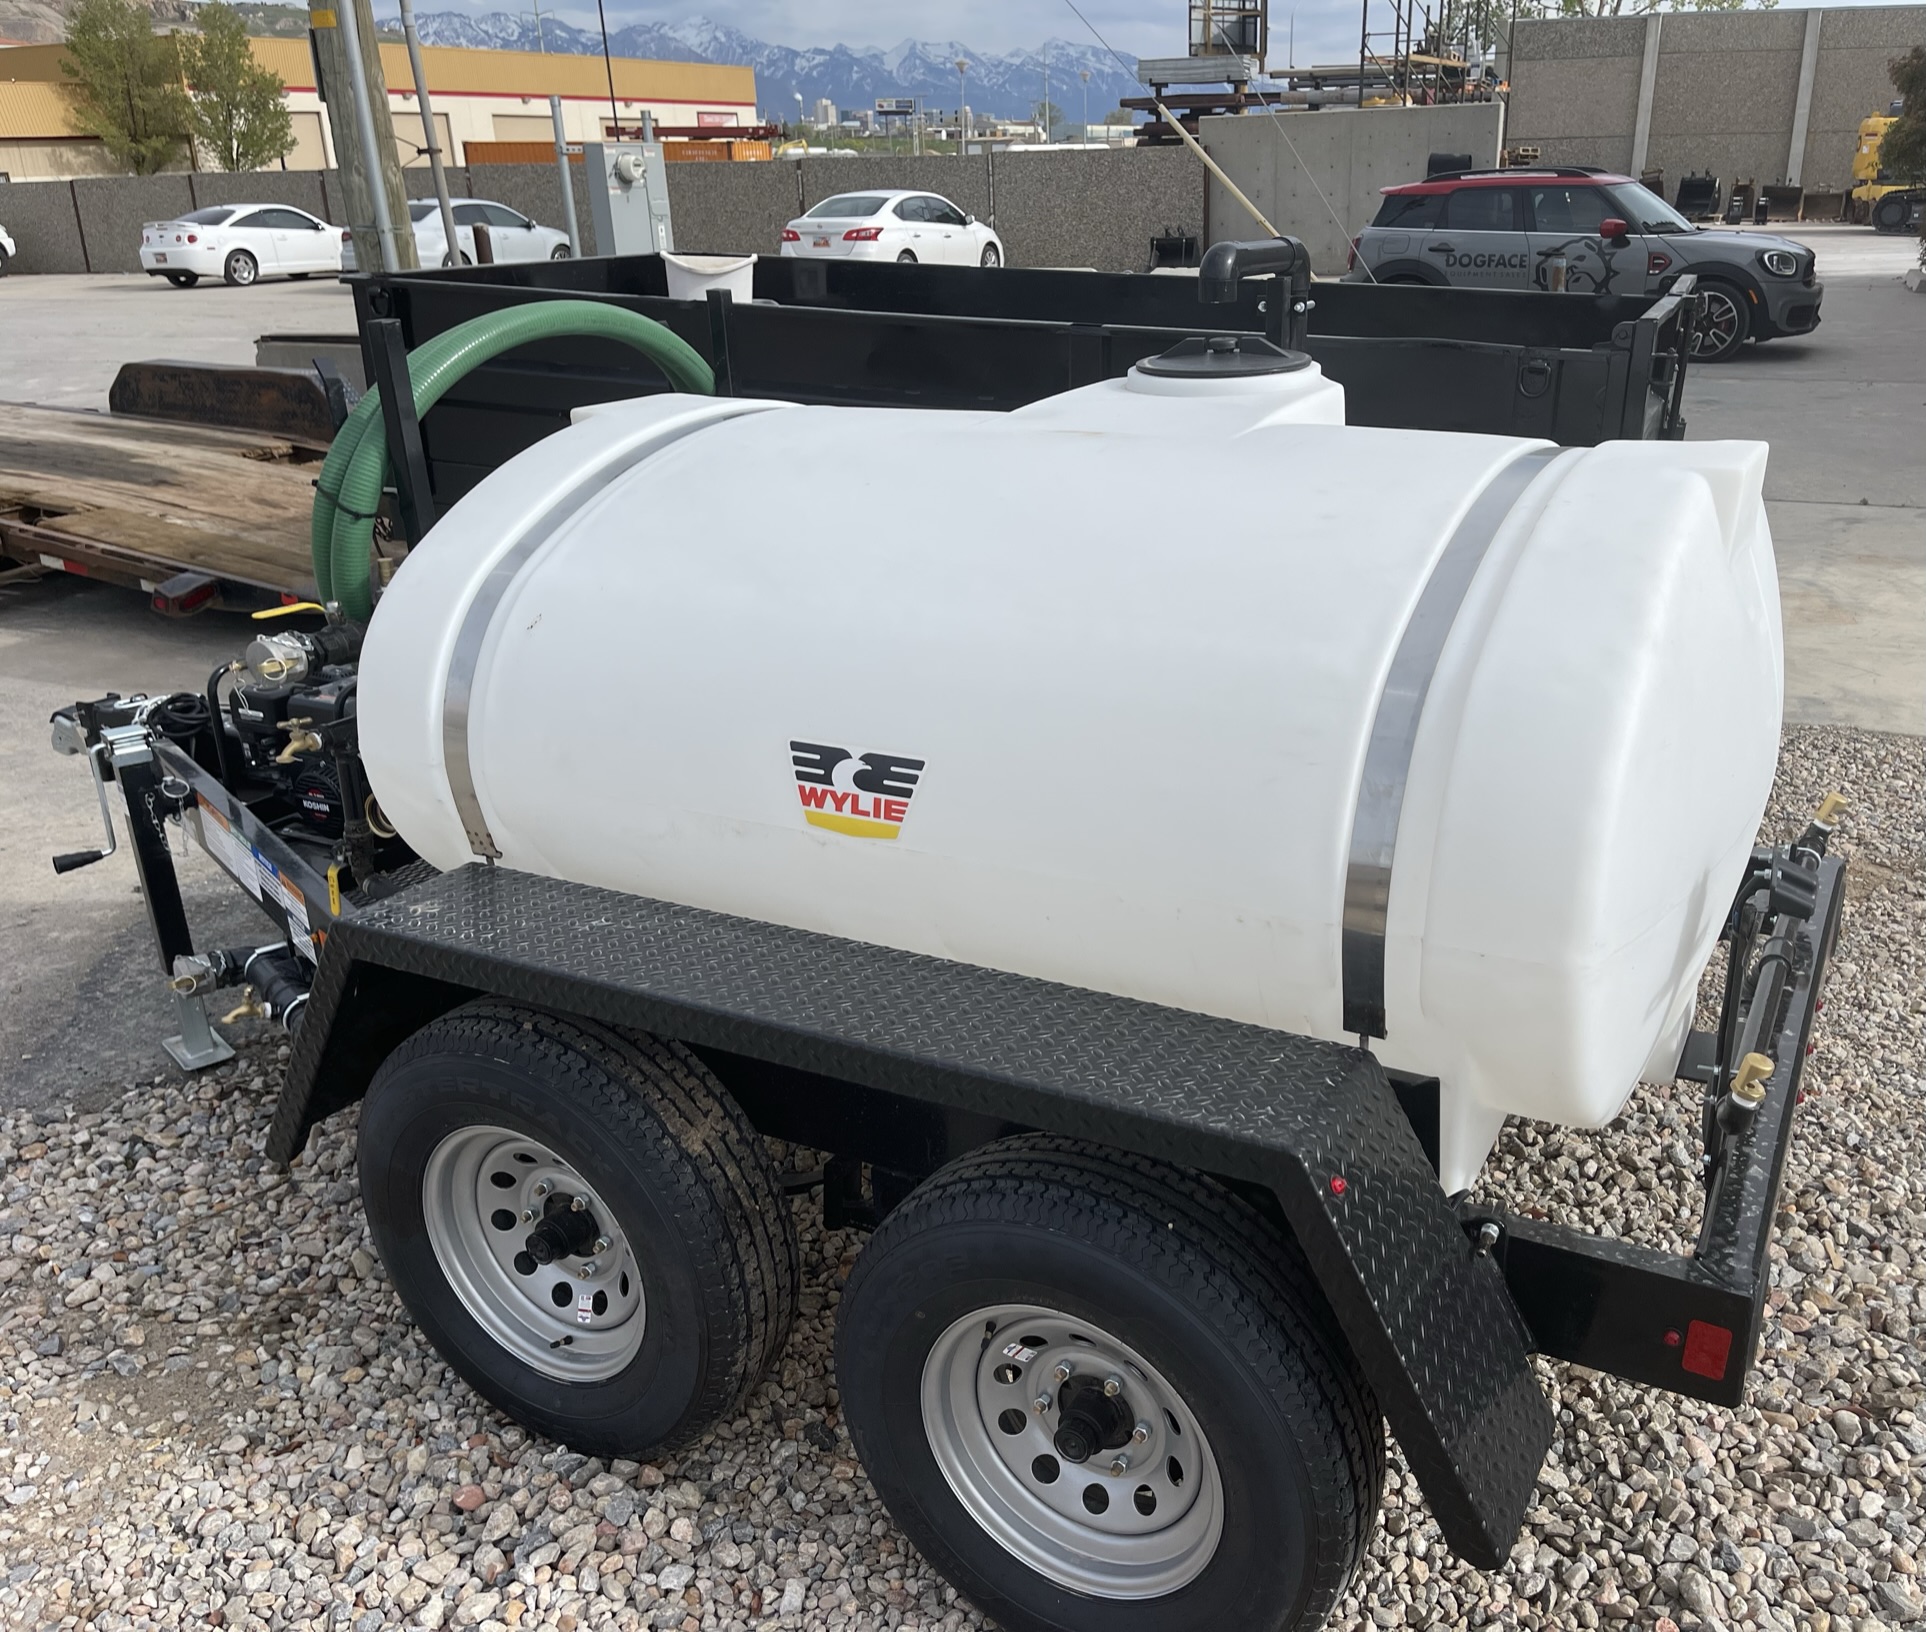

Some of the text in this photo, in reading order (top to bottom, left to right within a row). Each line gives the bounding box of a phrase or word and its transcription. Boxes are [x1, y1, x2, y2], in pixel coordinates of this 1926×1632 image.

[1445, 252, 1528, 269] DOGFACE
[1444, 270, 1497, 279] EQUIPMENT
[302, 799, 330, 812] KOSHIN
[797, 784, 909, 823] WYLIE
